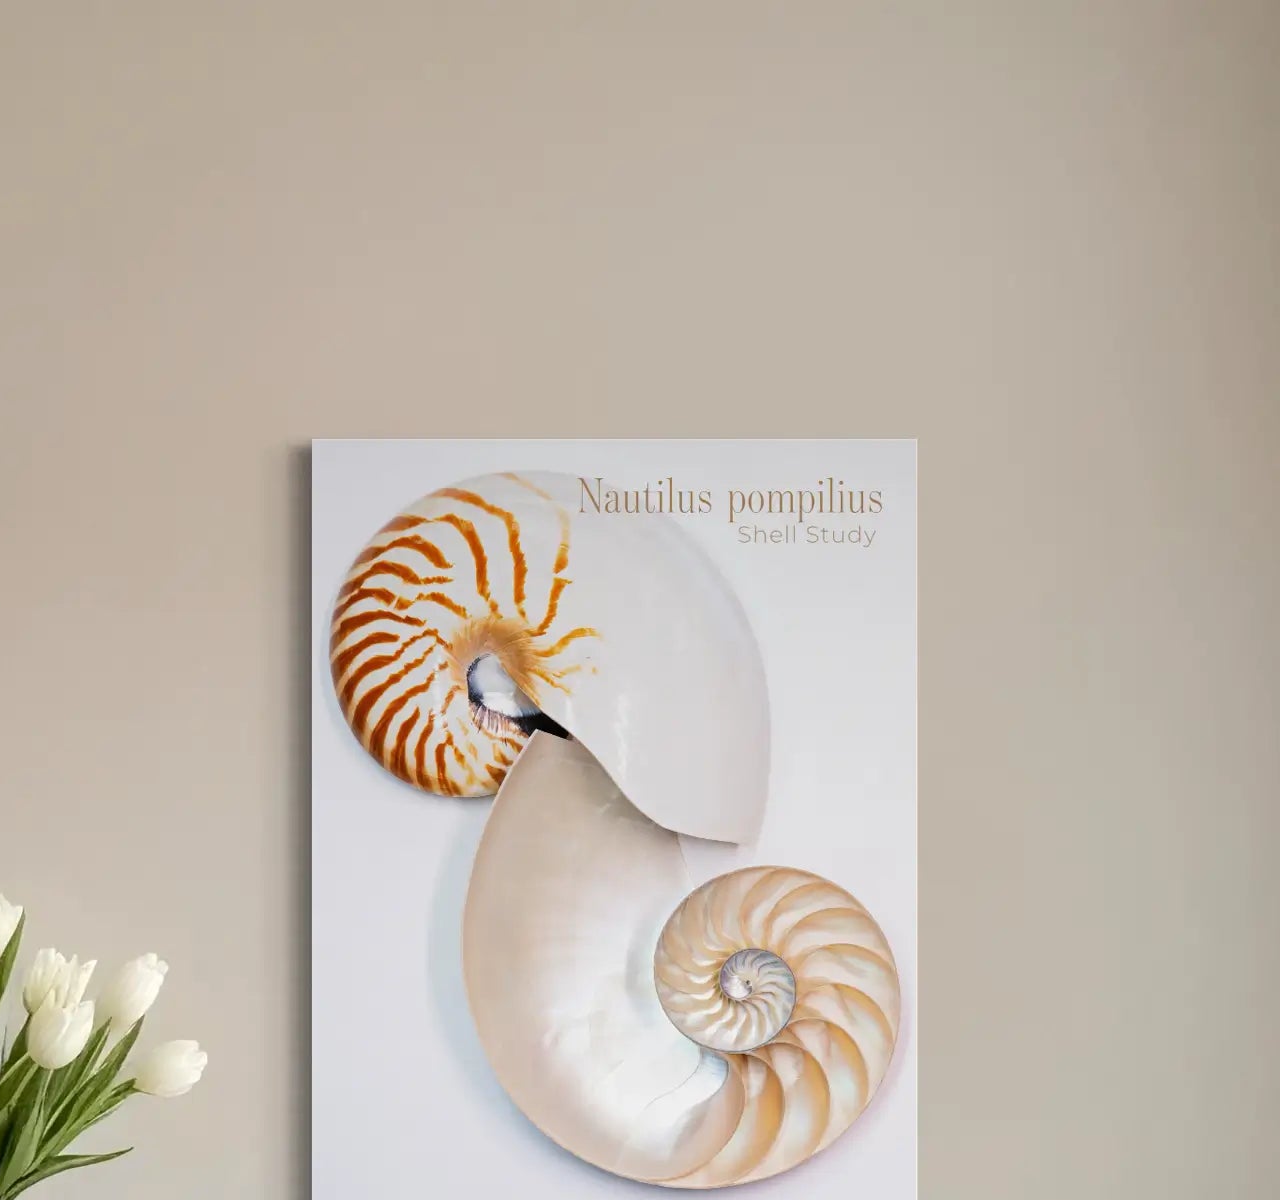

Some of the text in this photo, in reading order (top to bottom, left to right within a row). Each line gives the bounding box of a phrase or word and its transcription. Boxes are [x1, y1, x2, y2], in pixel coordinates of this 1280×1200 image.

[578, 477, 884, 523] Nautilus pompilius
[738, 525, 877, 548] Shell Study
